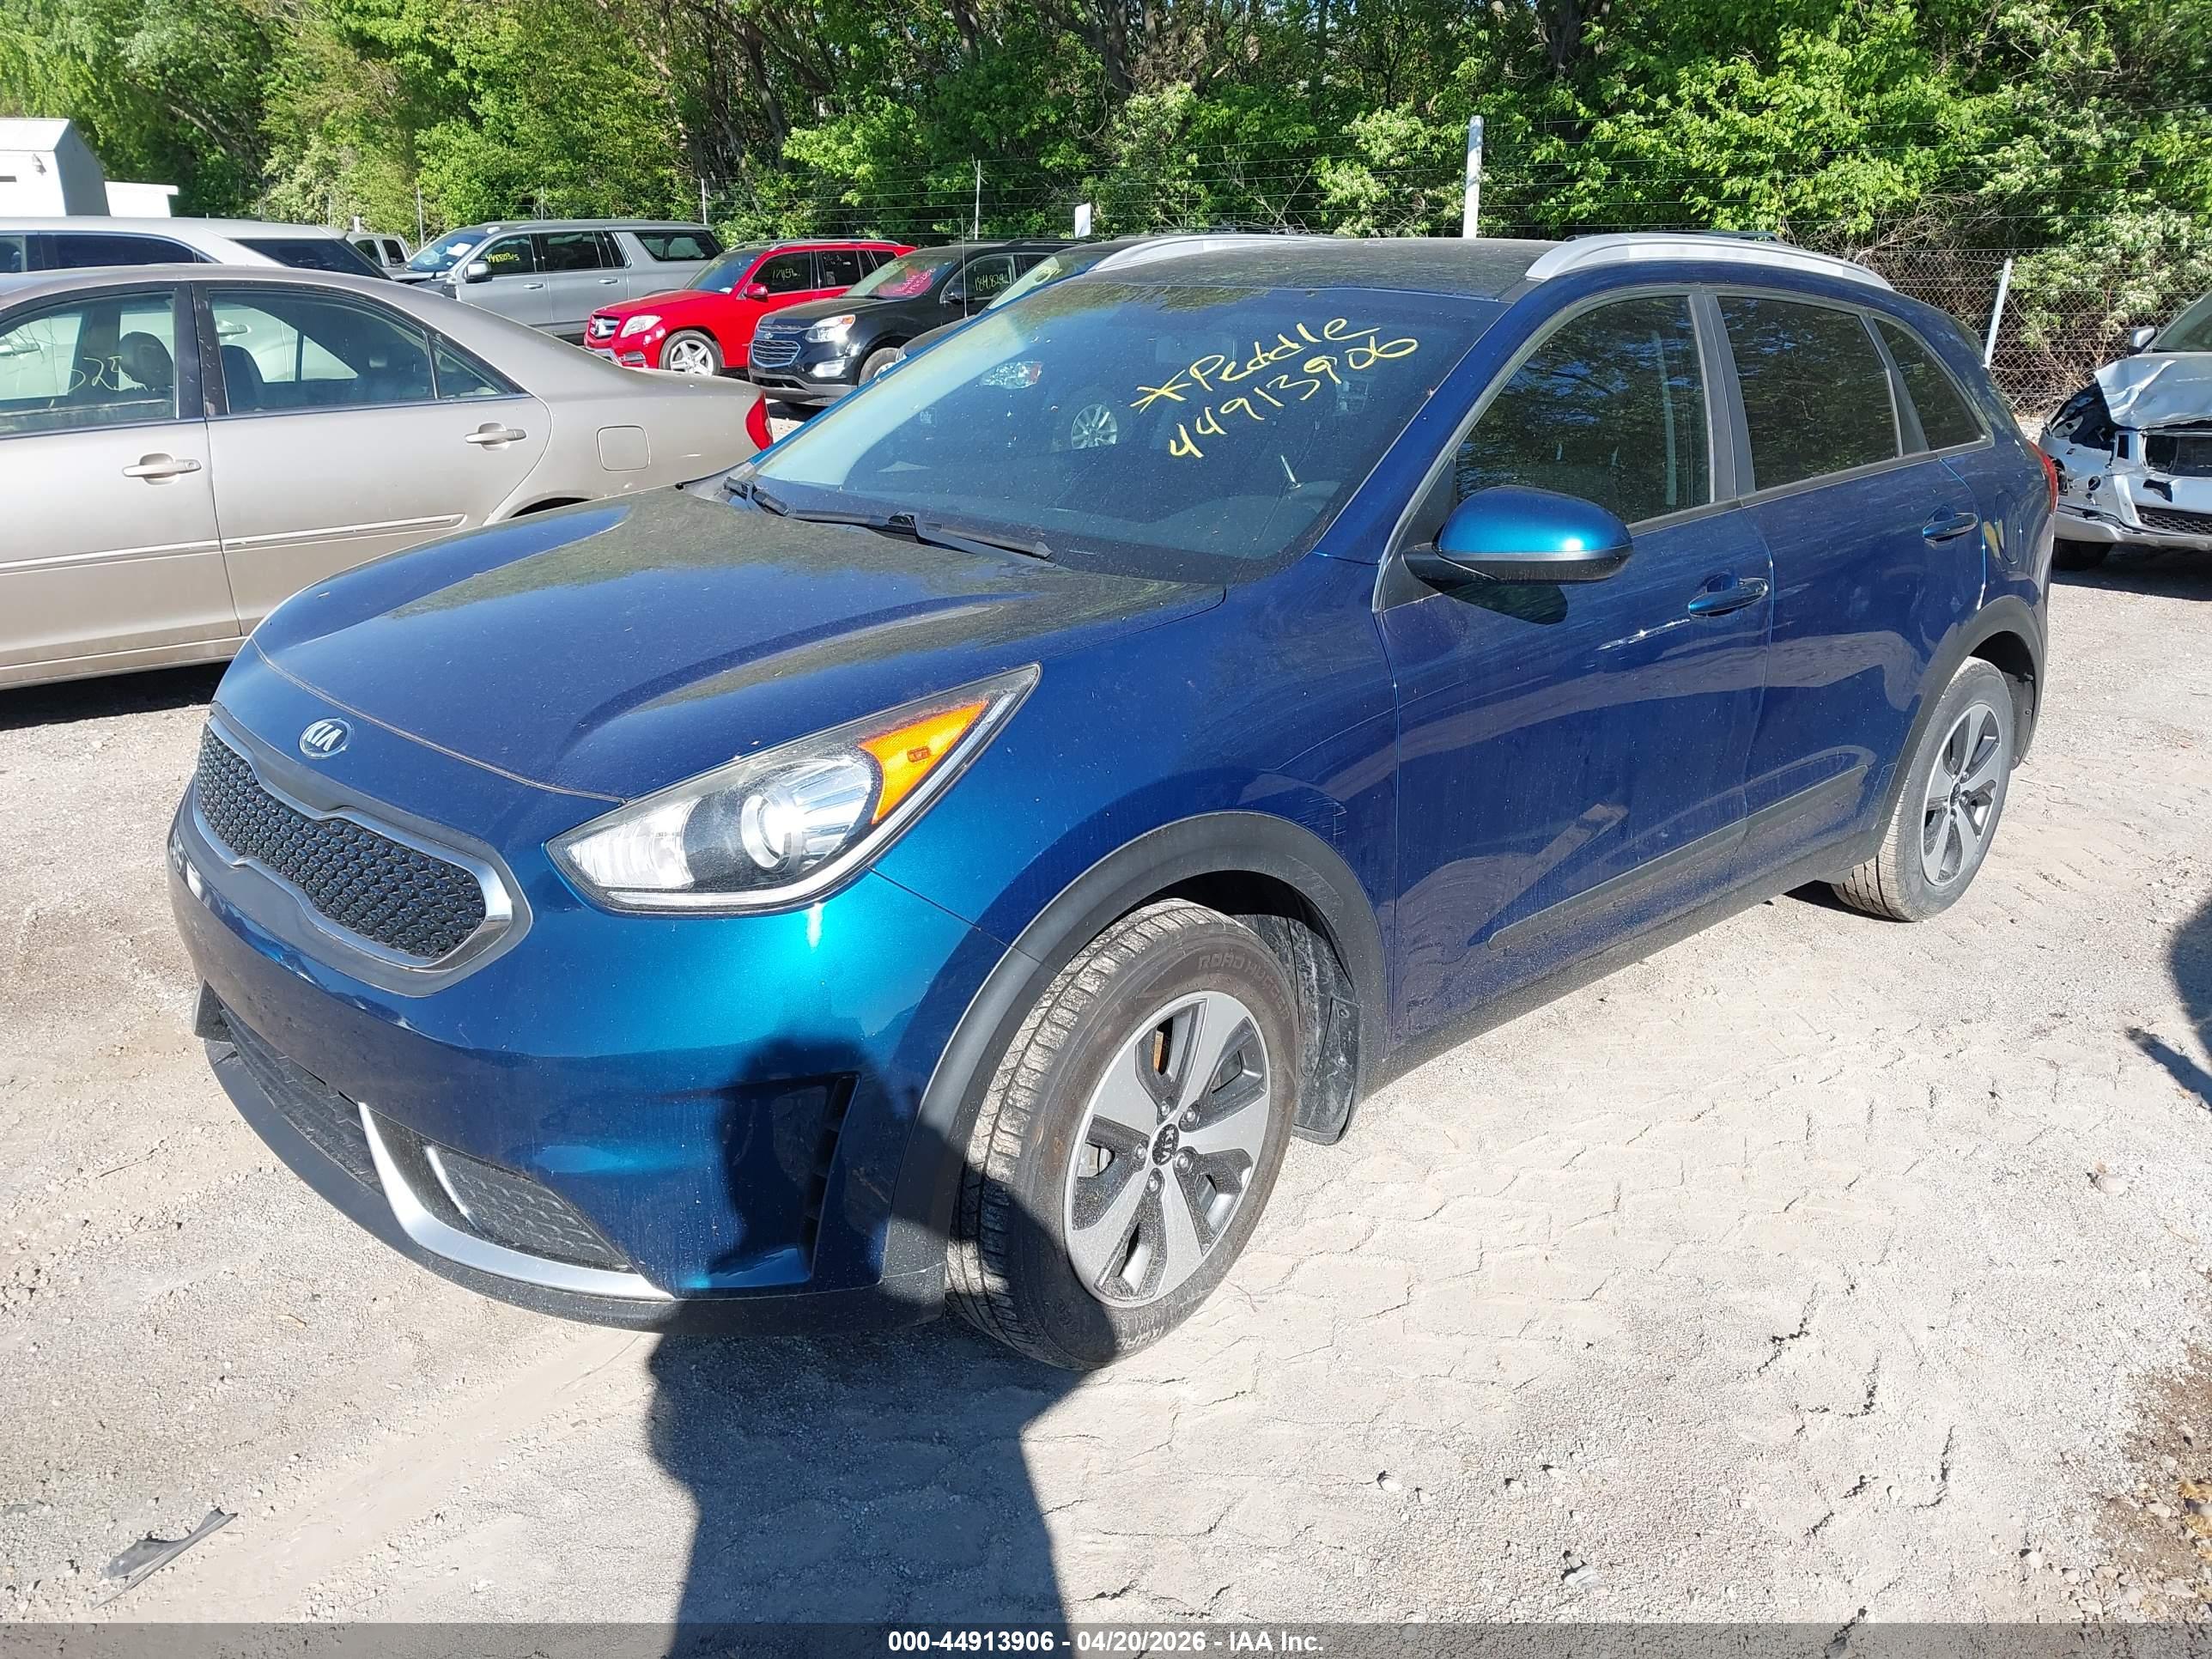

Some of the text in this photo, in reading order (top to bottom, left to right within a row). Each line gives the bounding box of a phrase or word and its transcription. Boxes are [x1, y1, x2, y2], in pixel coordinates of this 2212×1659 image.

[1168, 334, 1419, 459] 44913906
[302, 720, 343, 751] KIA
[1159, 1128, 1175, 1163] KIA
